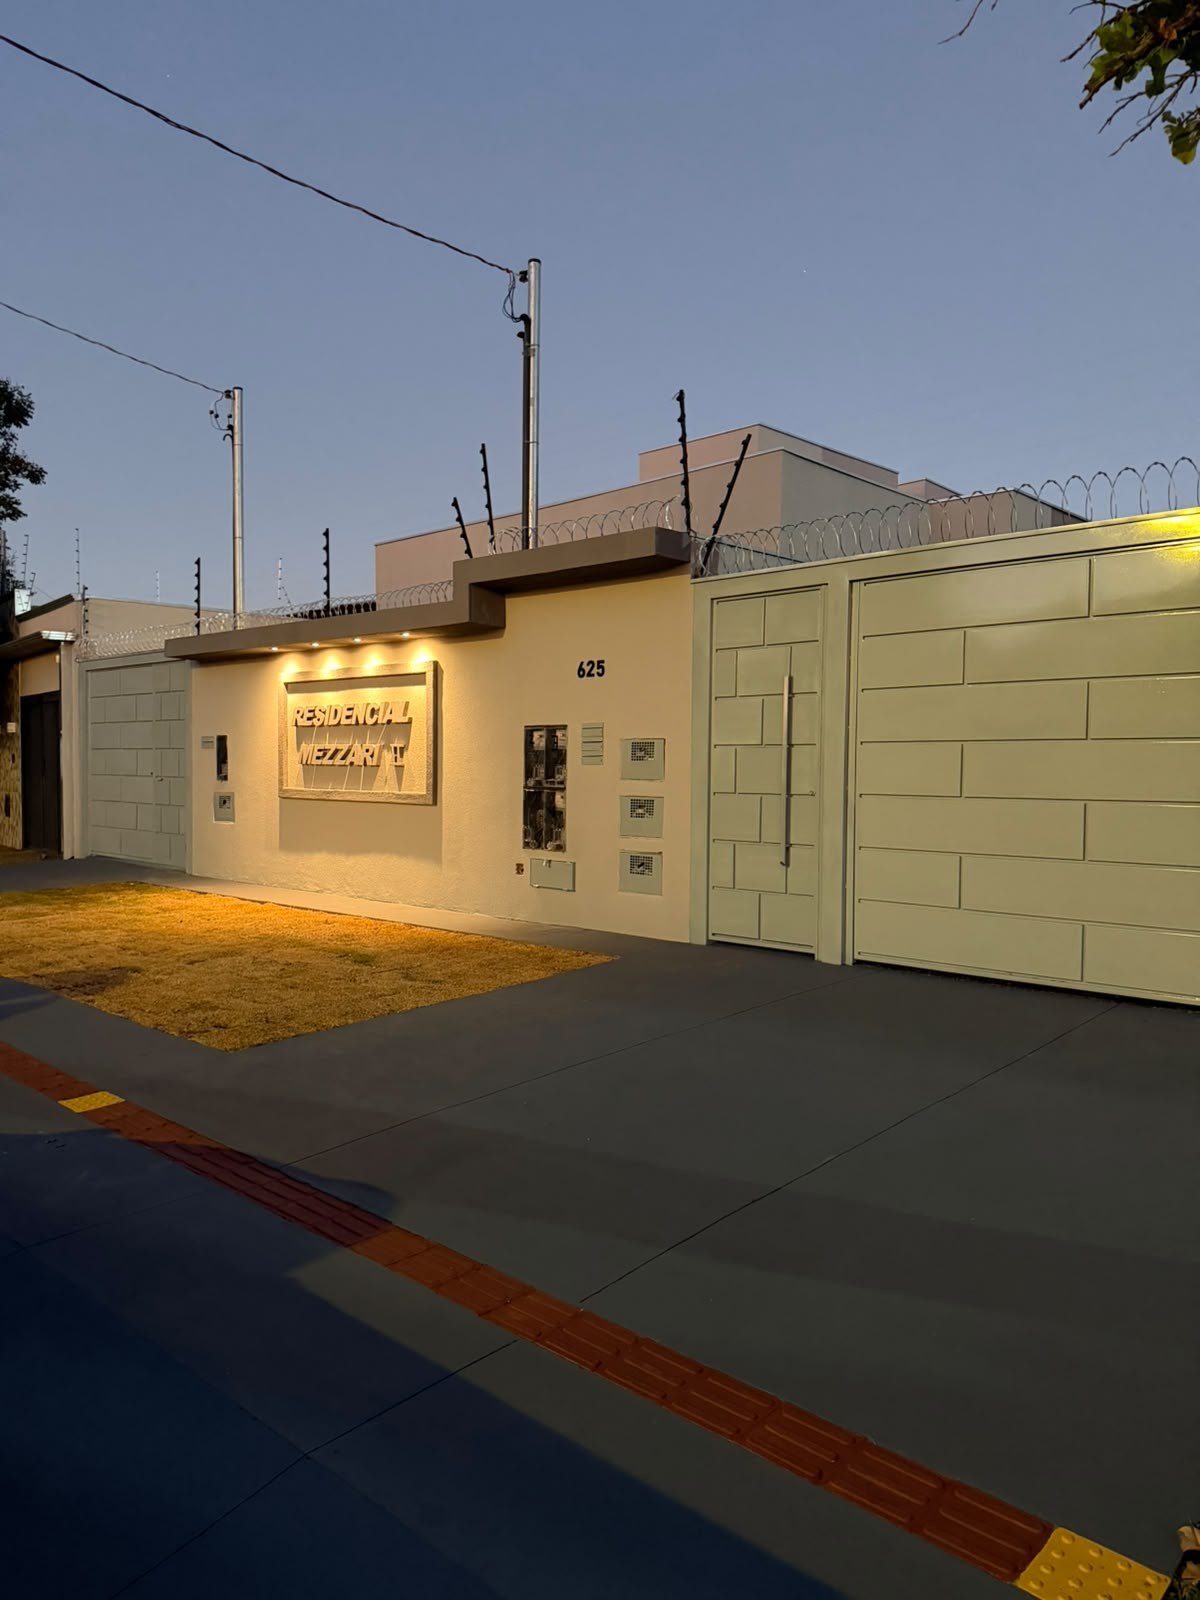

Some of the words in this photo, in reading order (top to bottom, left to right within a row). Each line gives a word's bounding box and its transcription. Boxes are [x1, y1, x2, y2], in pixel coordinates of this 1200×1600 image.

[577, 659, 605, 679] 625
[293, 702, 412, 727] RESIDENCIAL
[299, 743, 383, 767] MEZZARI
